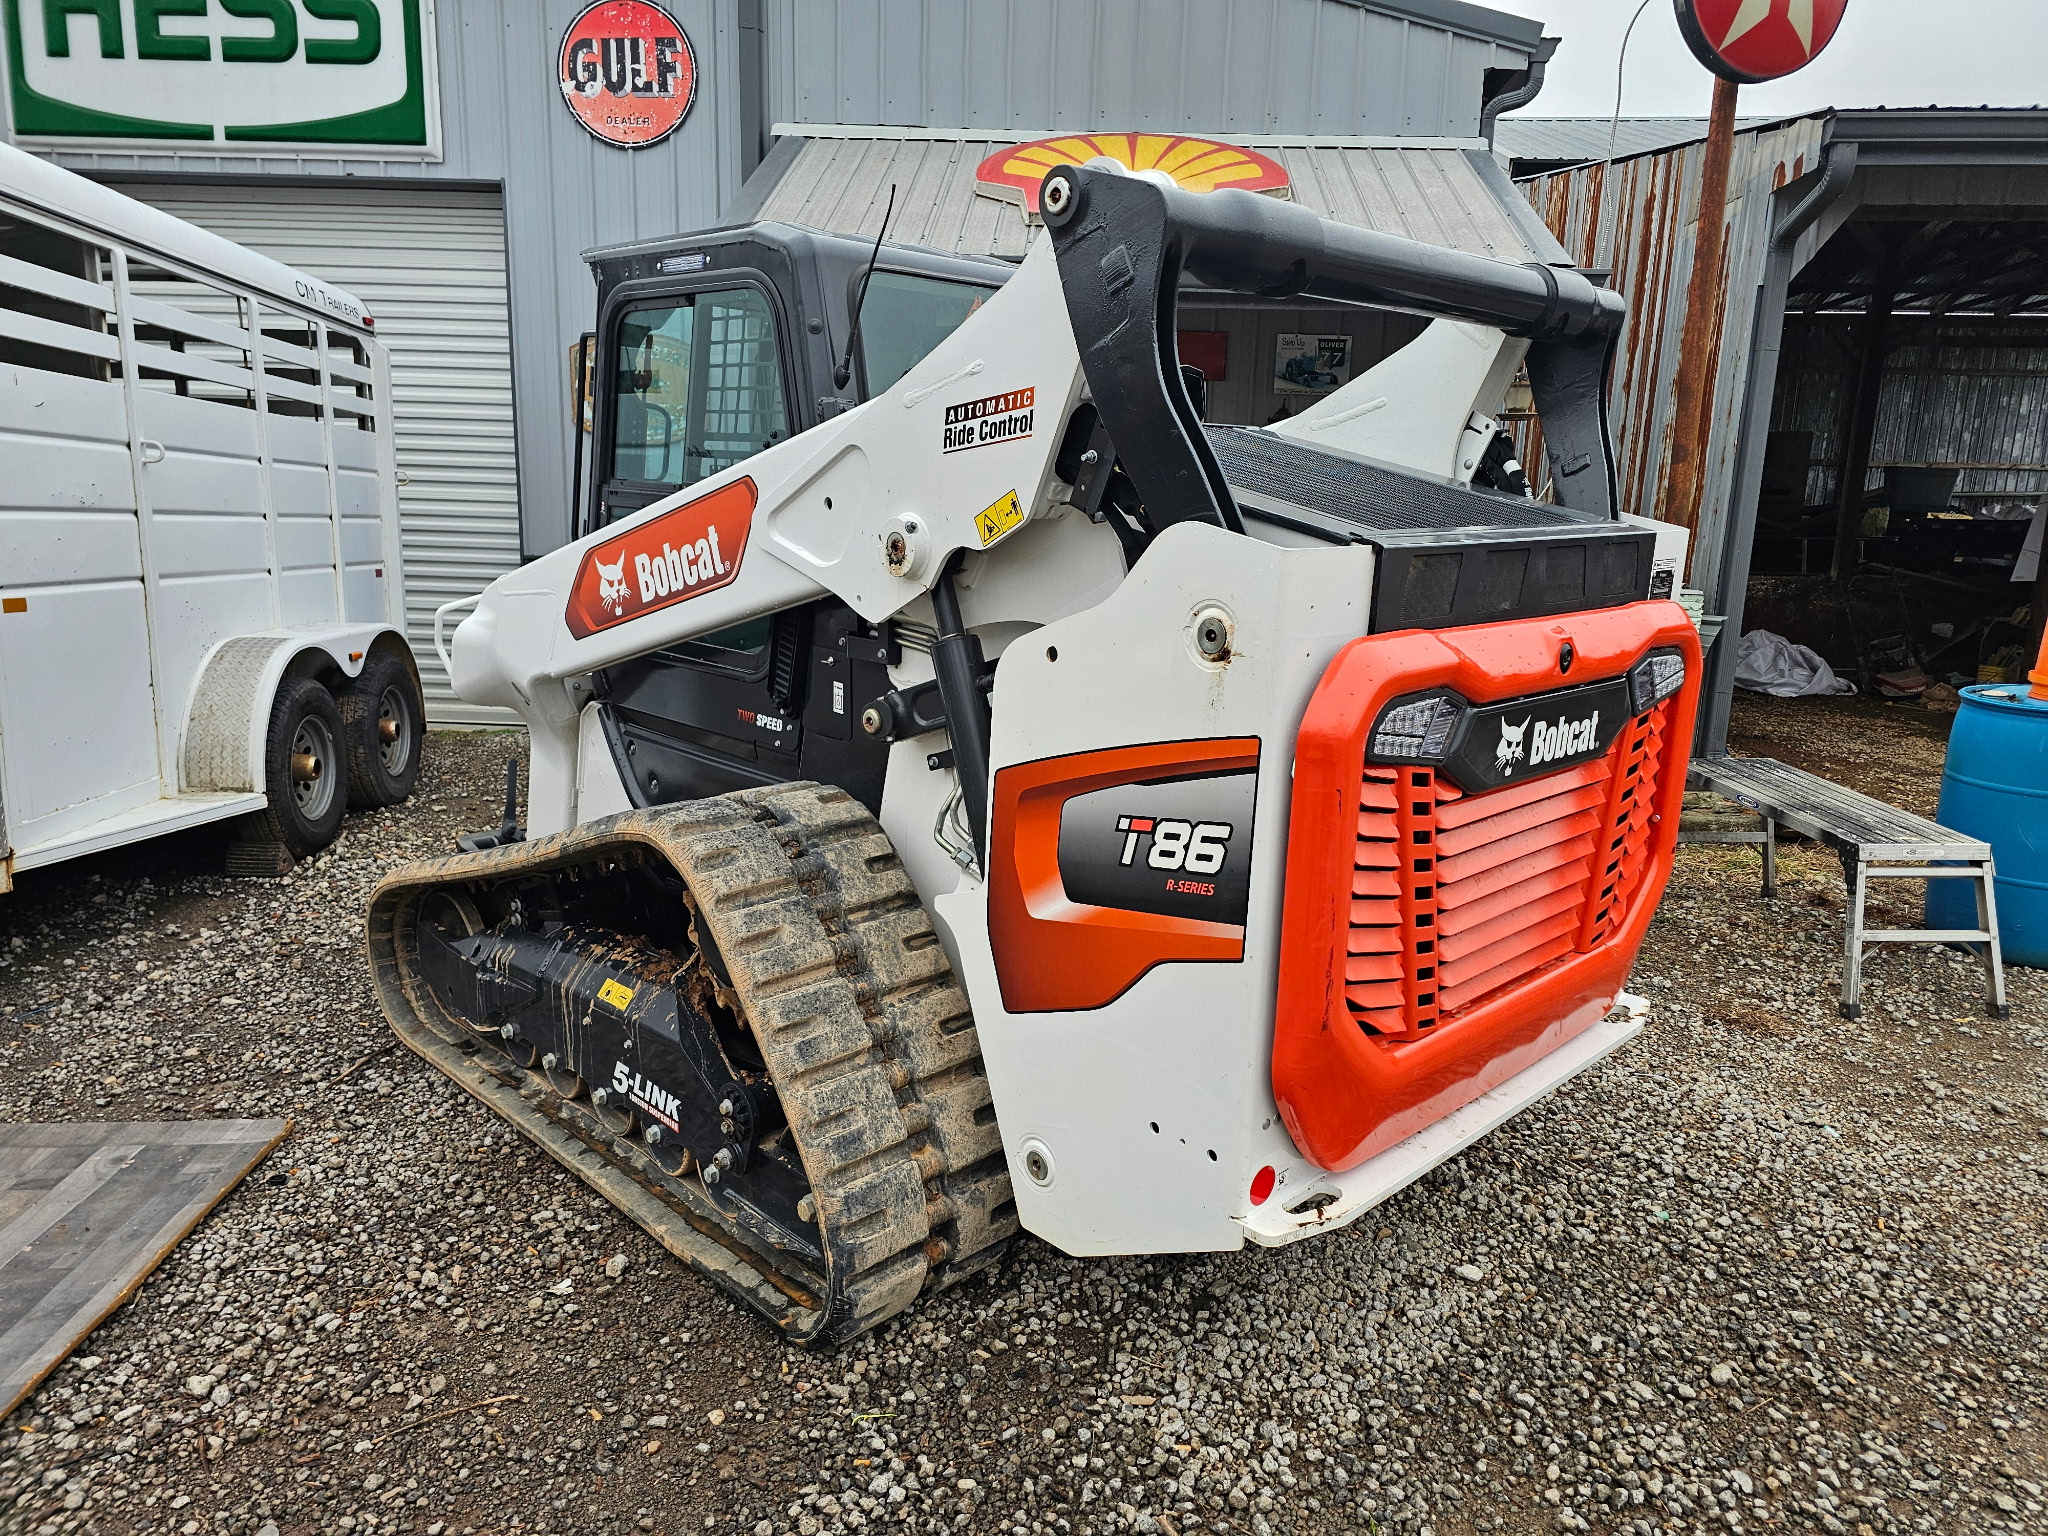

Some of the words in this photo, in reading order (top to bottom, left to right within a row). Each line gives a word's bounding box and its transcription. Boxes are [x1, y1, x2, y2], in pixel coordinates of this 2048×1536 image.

[568, 37, 683, 98] GULF
[606, 116, 651, 127] DEALER
[295, 280, 317, 302] CM
[1319, 341, 1345, 349] OLIVER
[1320, 352, 1343, 365] 77
[947, 390, 1032, 423] AUTOMATIC
[943, 424, 975, 449] Ride
[979, 409, 1034, 442] Control
[634, 525, 725, 604] Bobcat
[737, 708, 755, 724] TWO
[756, 713, 783, 732] SPEED
[1529, 710, 1599, 766] Bobcat
[1115, 814, 1234, 877] T86
[1166, 878, 1215, 896] R-SERIES
[612, 1060, 682, 1122] 5-LINK
